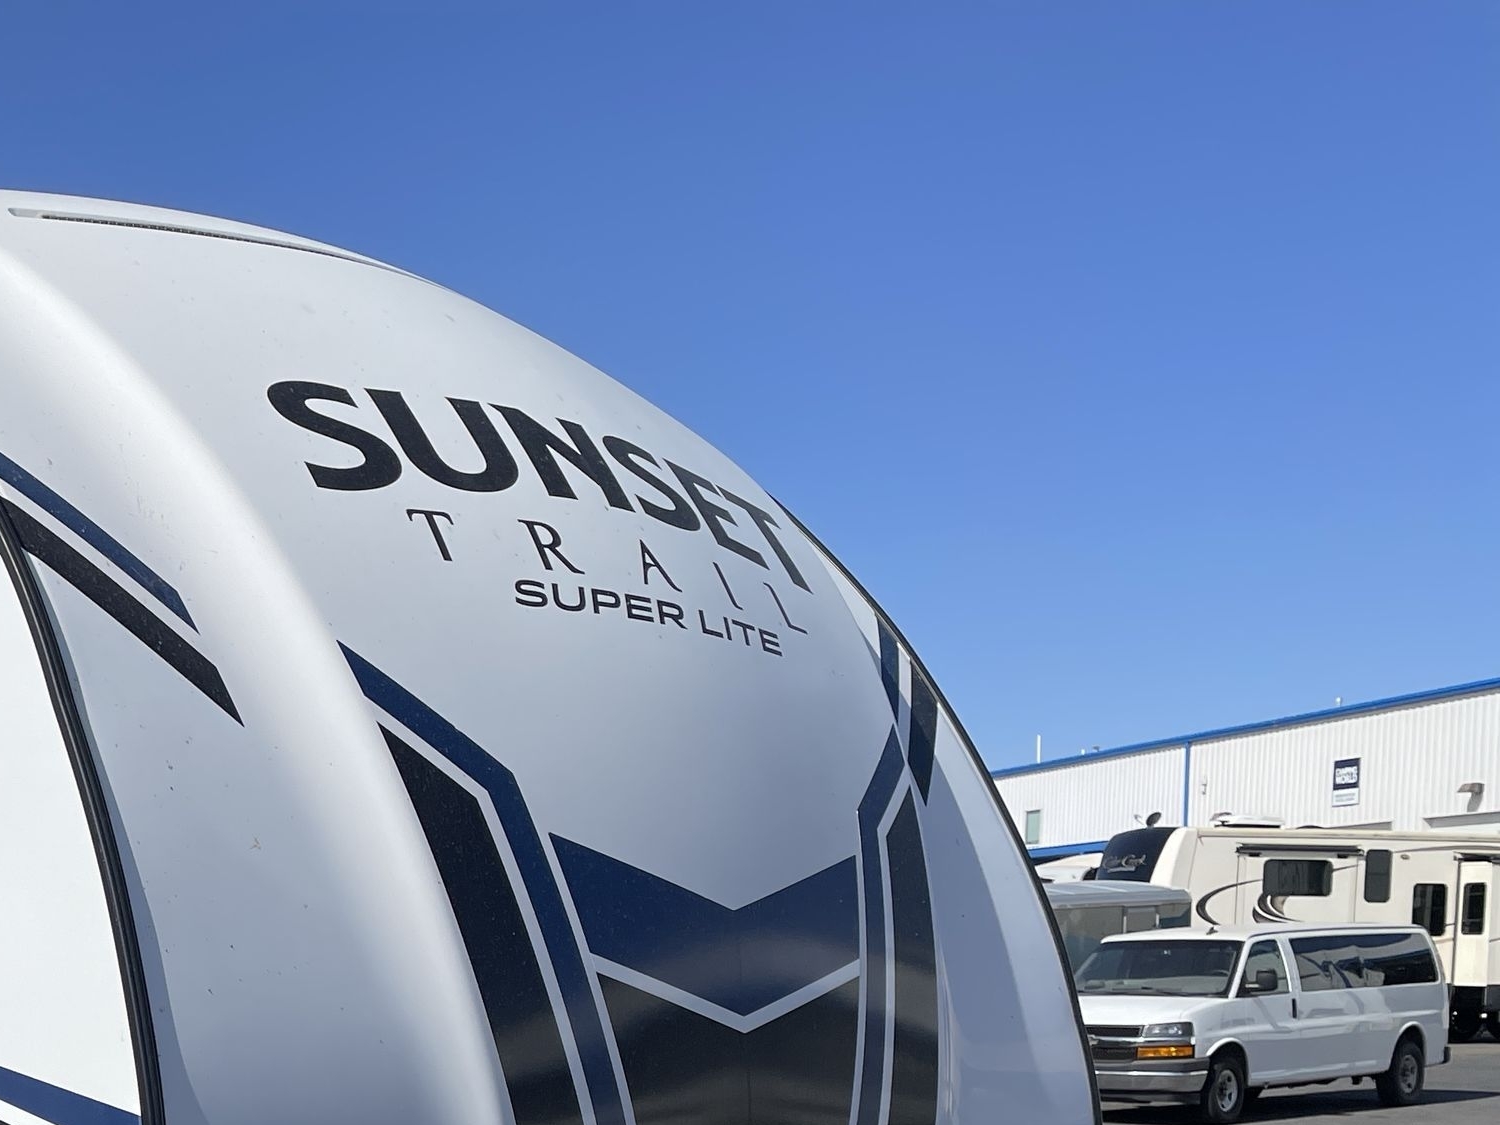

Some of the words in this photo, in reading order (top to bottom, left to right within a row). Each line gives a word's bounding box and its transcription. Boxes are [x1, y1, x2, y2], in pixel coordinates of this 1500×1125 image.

[266, 380, 813, 594] SUNSET
[405, 508, 808, 635] TRAIL
[514, 579, 688, 630] SUPER
[698, 609, 783, 657] LITE
